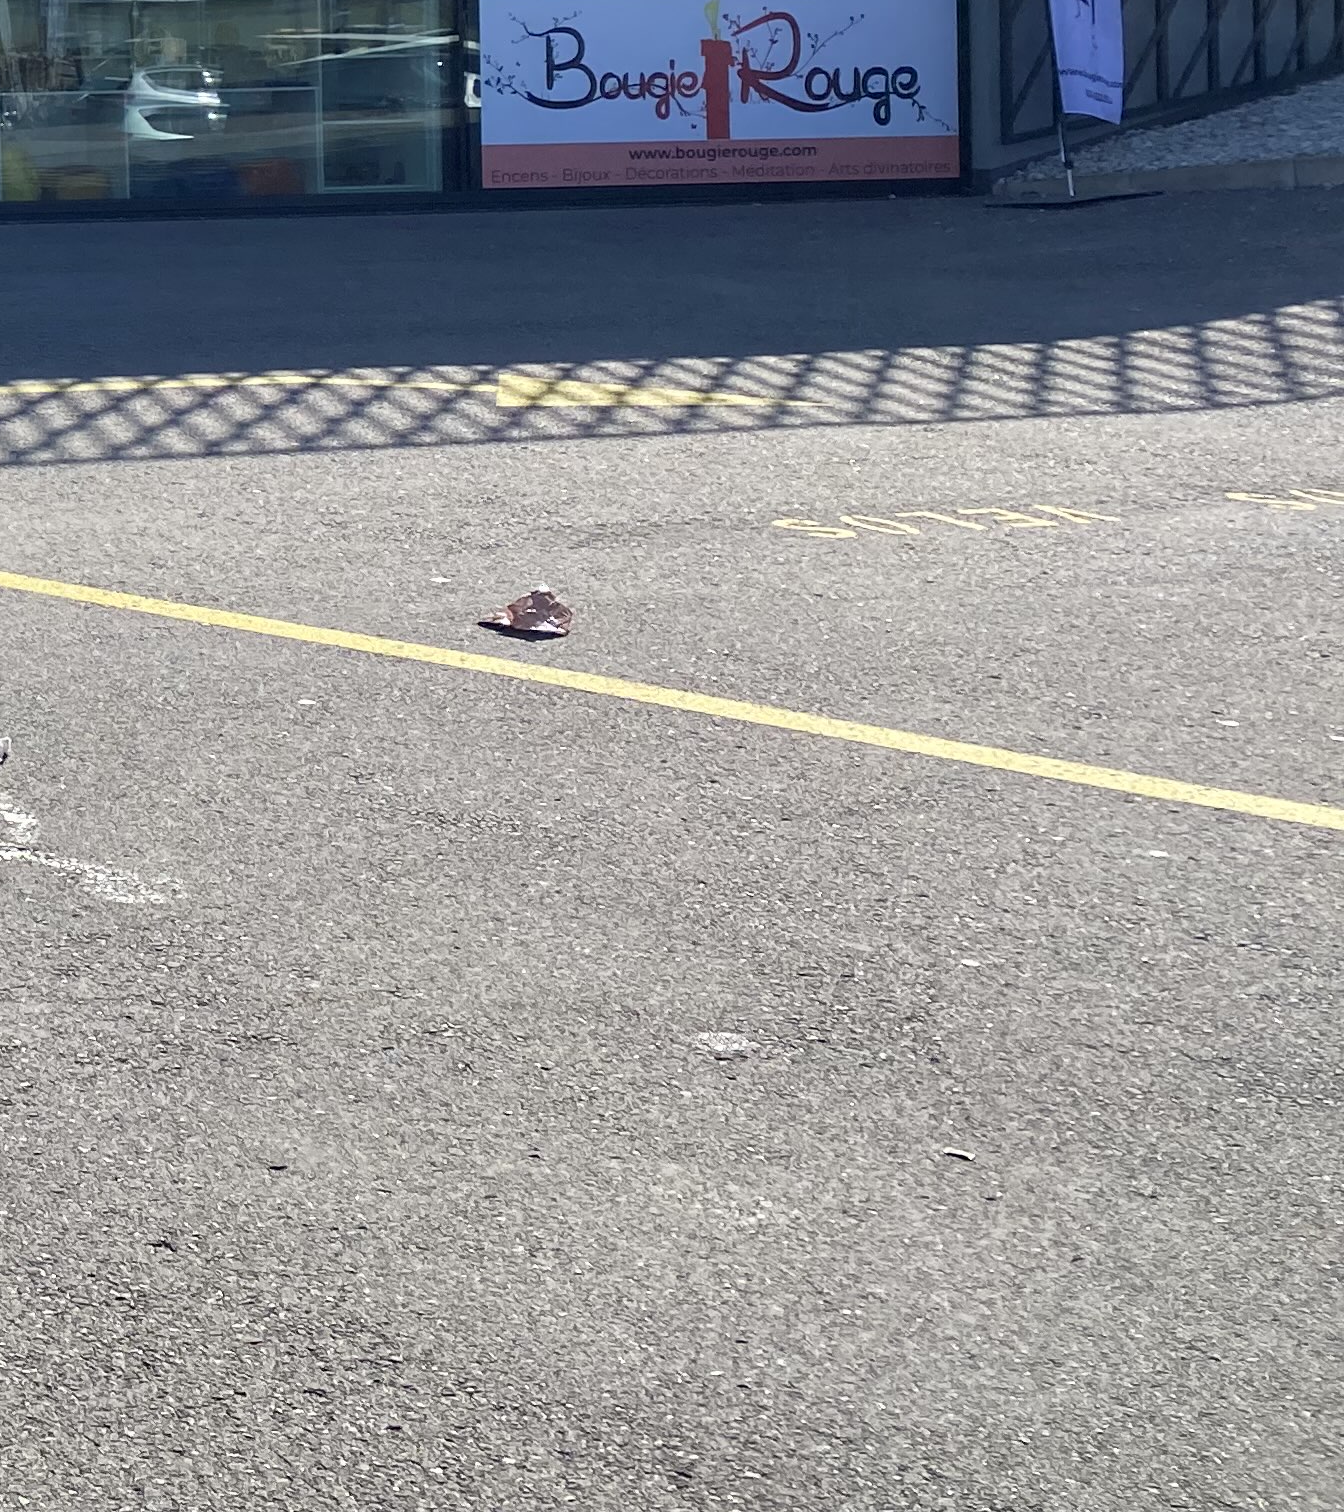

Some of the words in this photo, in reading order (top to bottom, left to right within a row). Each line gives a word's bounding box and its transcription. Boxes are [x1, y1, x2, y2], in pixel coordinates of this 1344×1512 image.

[525, 26, 702, 120] Bougie
[731, 11, 921, 126] Rouge
[628, 144, 817, 161] www.bougierouge.com
